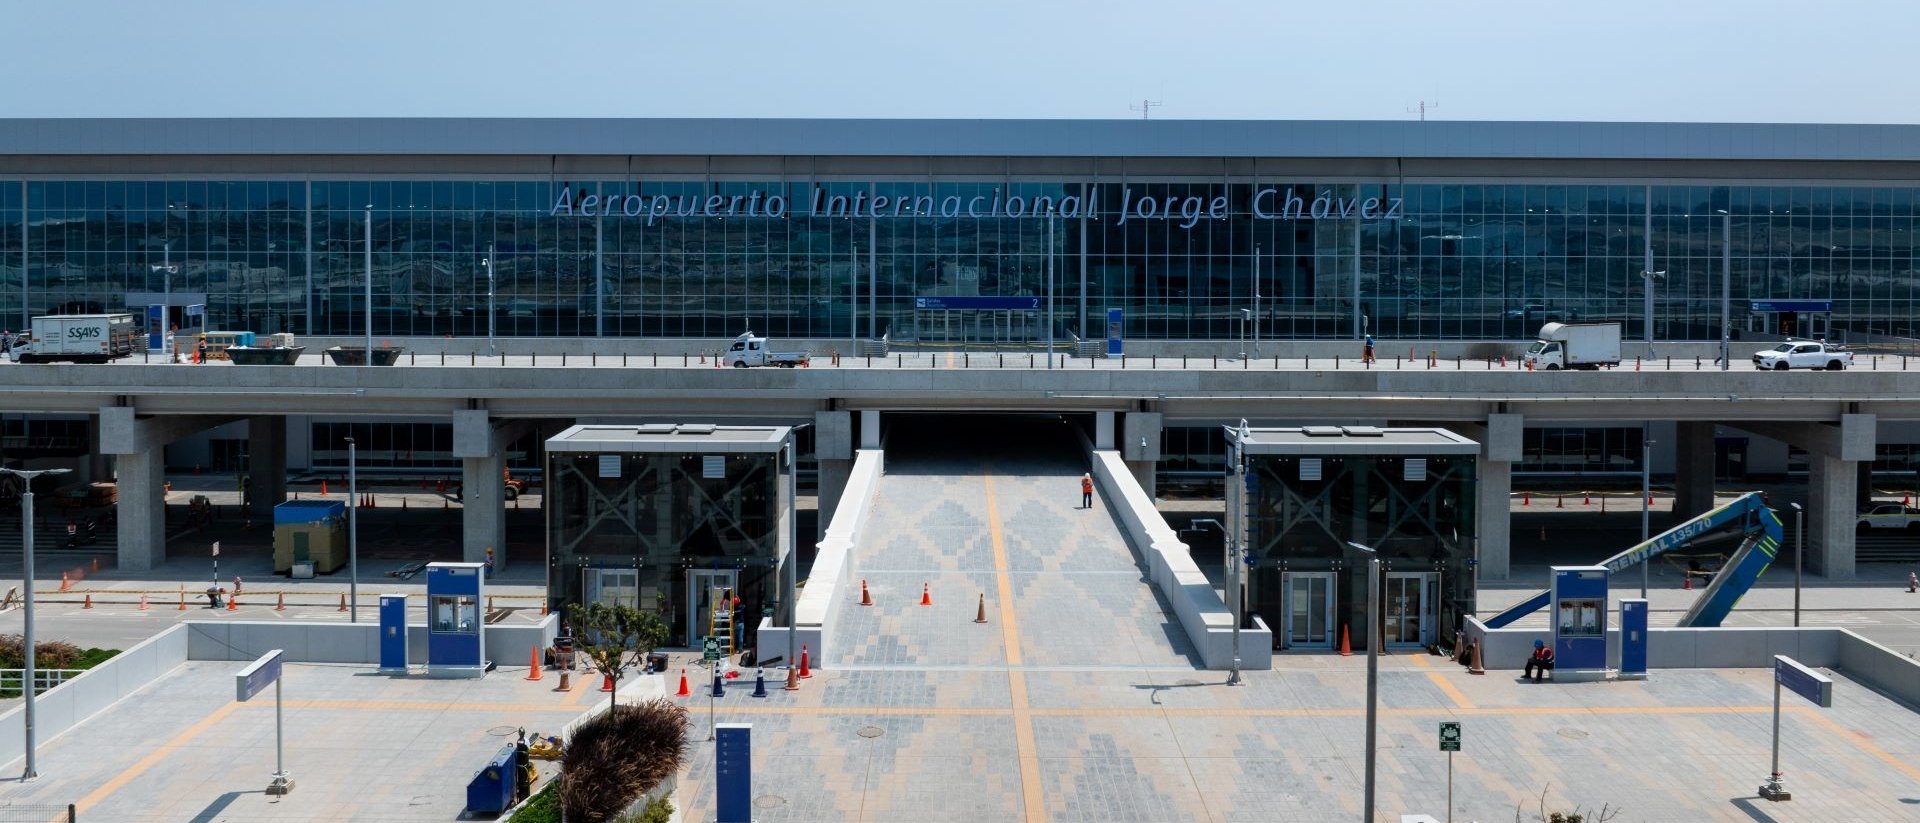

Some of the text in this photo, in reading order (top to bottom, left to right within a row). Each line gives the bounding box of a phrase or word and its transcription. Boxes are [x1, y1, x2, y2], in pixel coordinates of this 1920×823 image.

[550, 186, 1404, 229] Aeropuerto Internacional Jorge Chávez
[1032, 298, 1039, 308] 2
[68, 327, 101, 340] SSAYS
[1607, 518, 1712, 576] RENTAL 135/70
